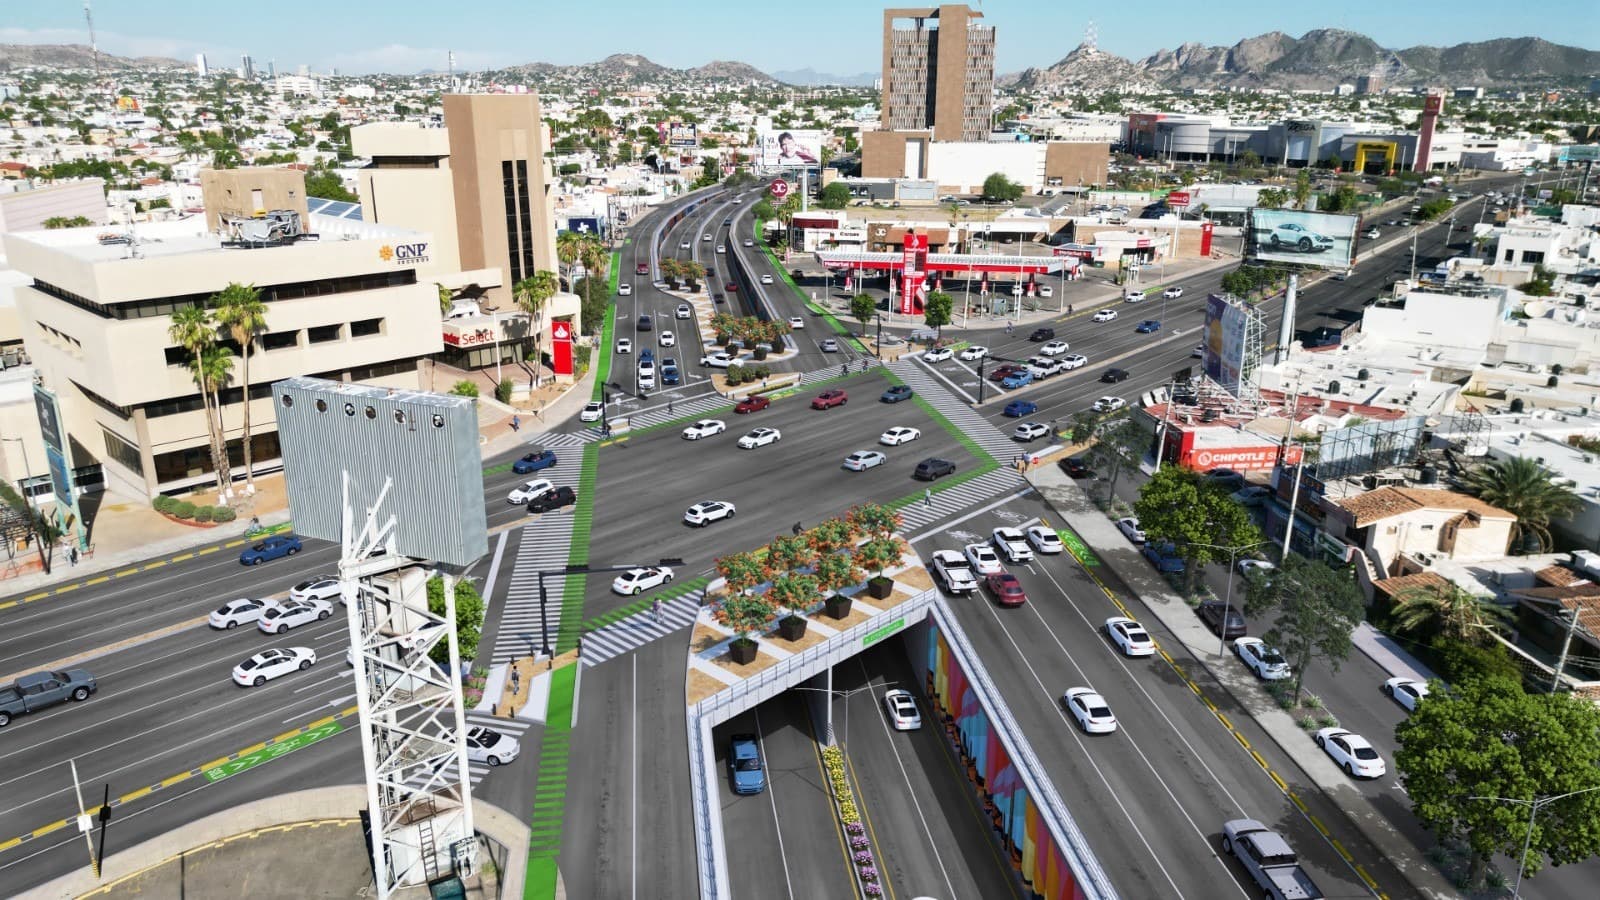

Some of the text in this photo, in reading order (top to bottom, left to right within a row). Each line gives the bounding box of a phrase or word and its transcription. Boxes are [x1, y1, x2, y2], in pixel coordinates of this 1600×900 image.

[396, 243, 426, 258] GNP
[462, 329, 494, 345] Select
[1213, 453, 1264, 462] CHIPOTLE
